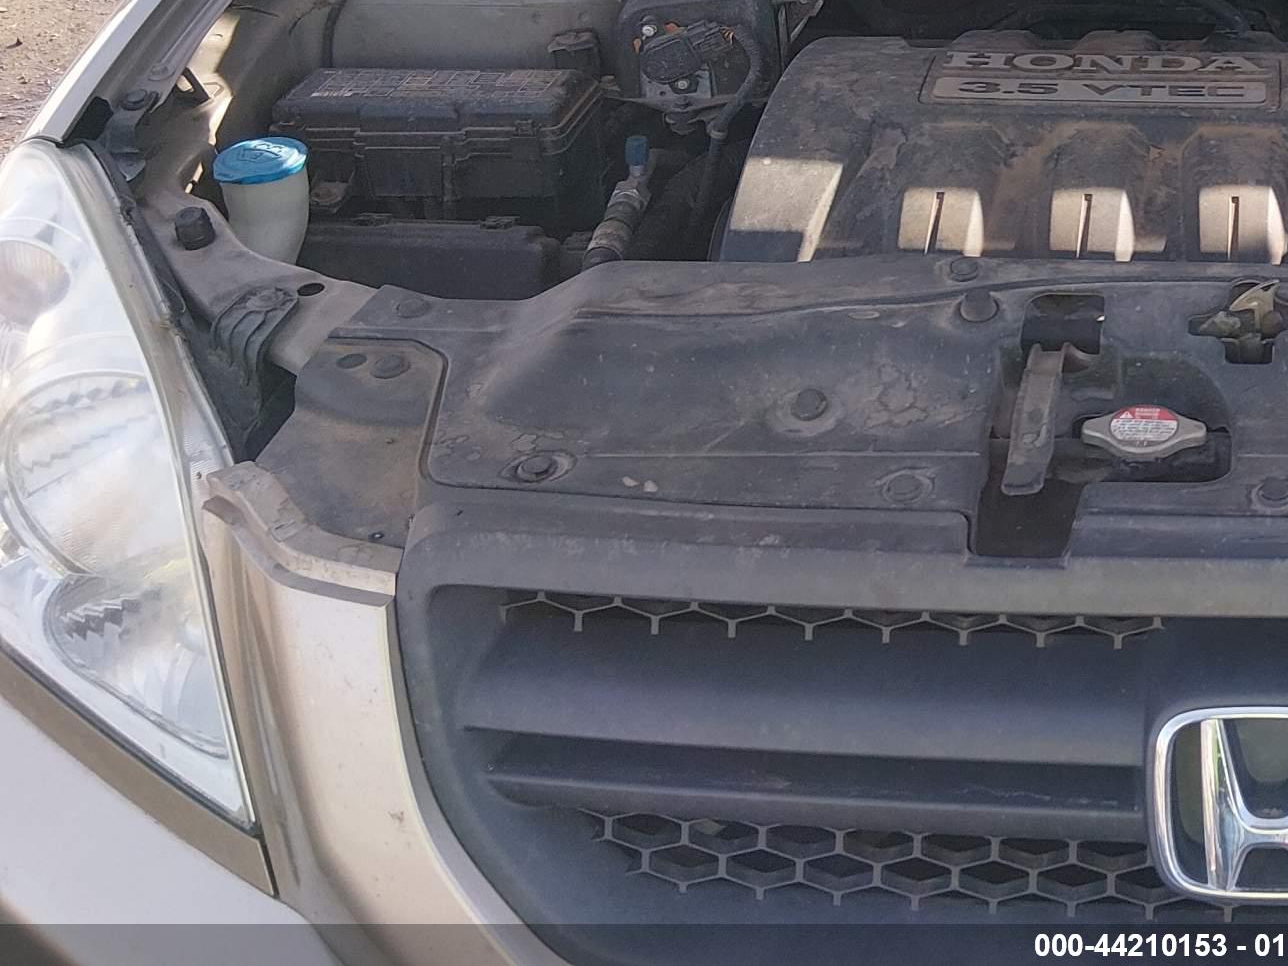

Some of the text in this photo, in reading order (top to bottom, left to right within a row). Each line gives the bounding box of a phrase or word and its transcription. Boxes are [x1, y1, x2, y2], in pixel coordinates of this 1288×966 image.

[943, 50, 1265, 74] HONDA
[958, 80, 1245, 98] 3.5 VTEC
